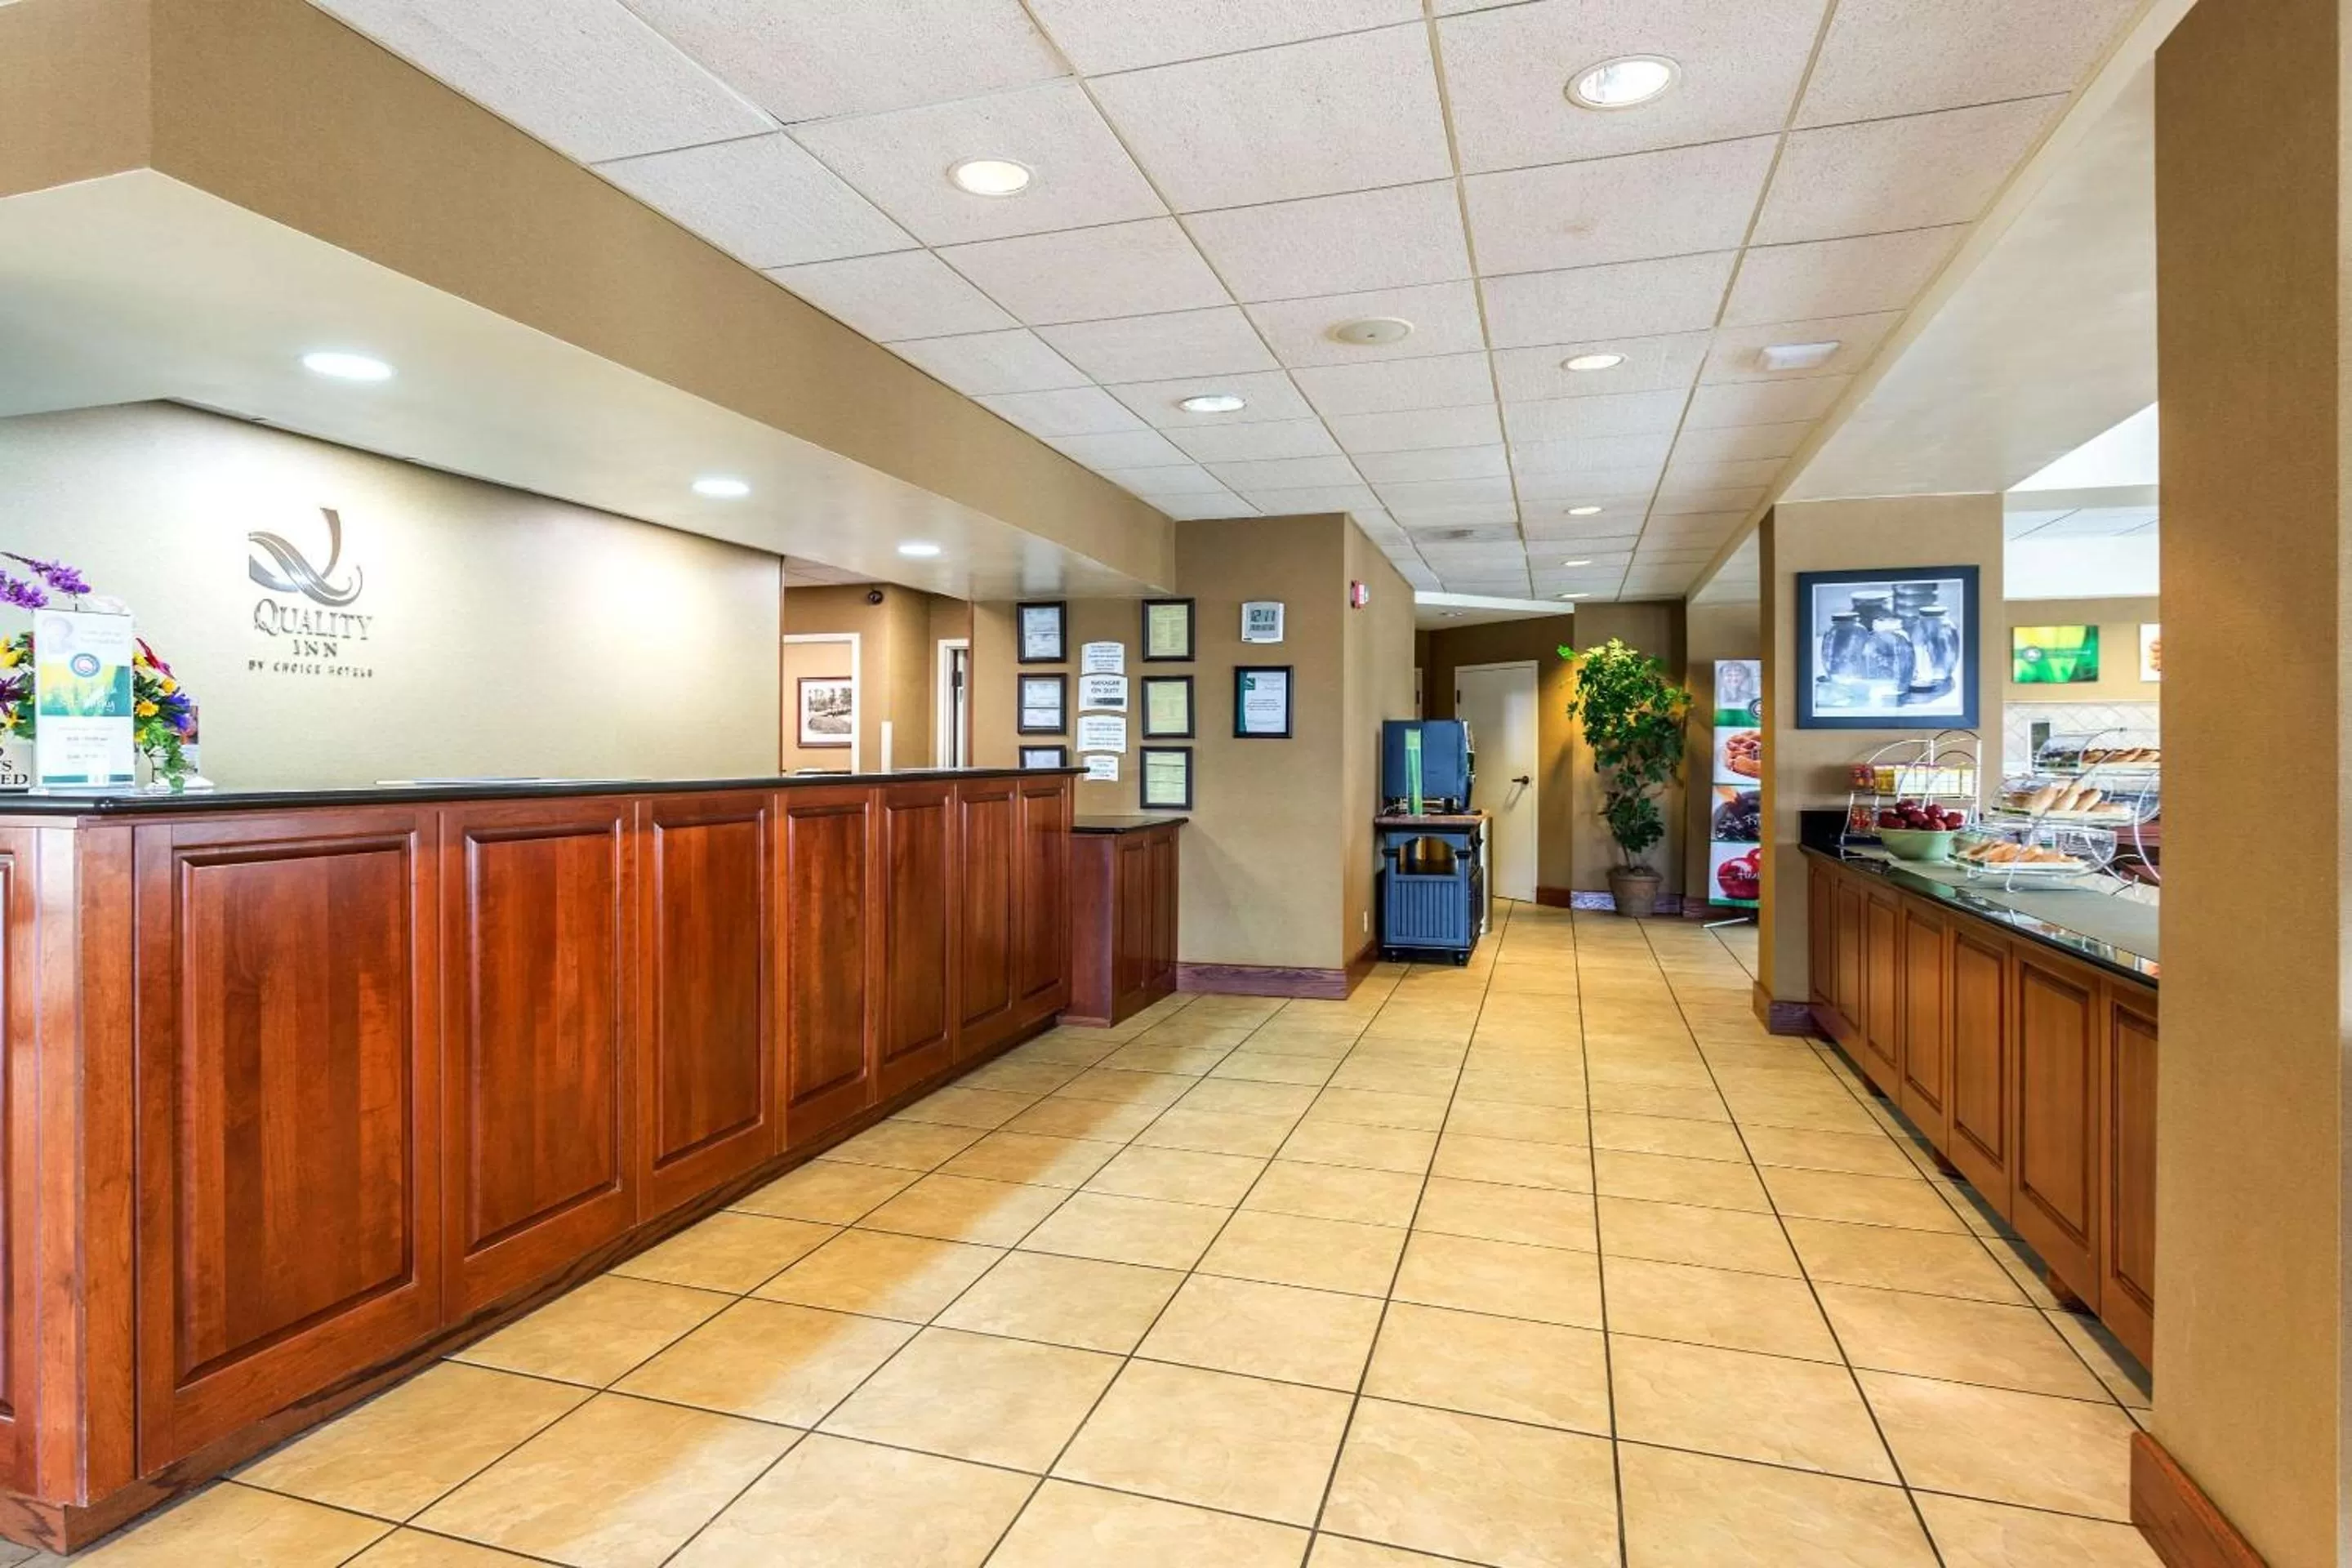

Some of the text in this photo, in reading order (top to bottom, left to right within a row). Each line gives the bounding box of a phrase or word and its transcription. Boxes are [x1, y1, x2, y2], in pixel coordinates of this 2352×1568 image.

[253, 598, 372, 639] QUALITY
[292, 639, 337, 657] INN
[273, 662, 321, 675] CHOICE
